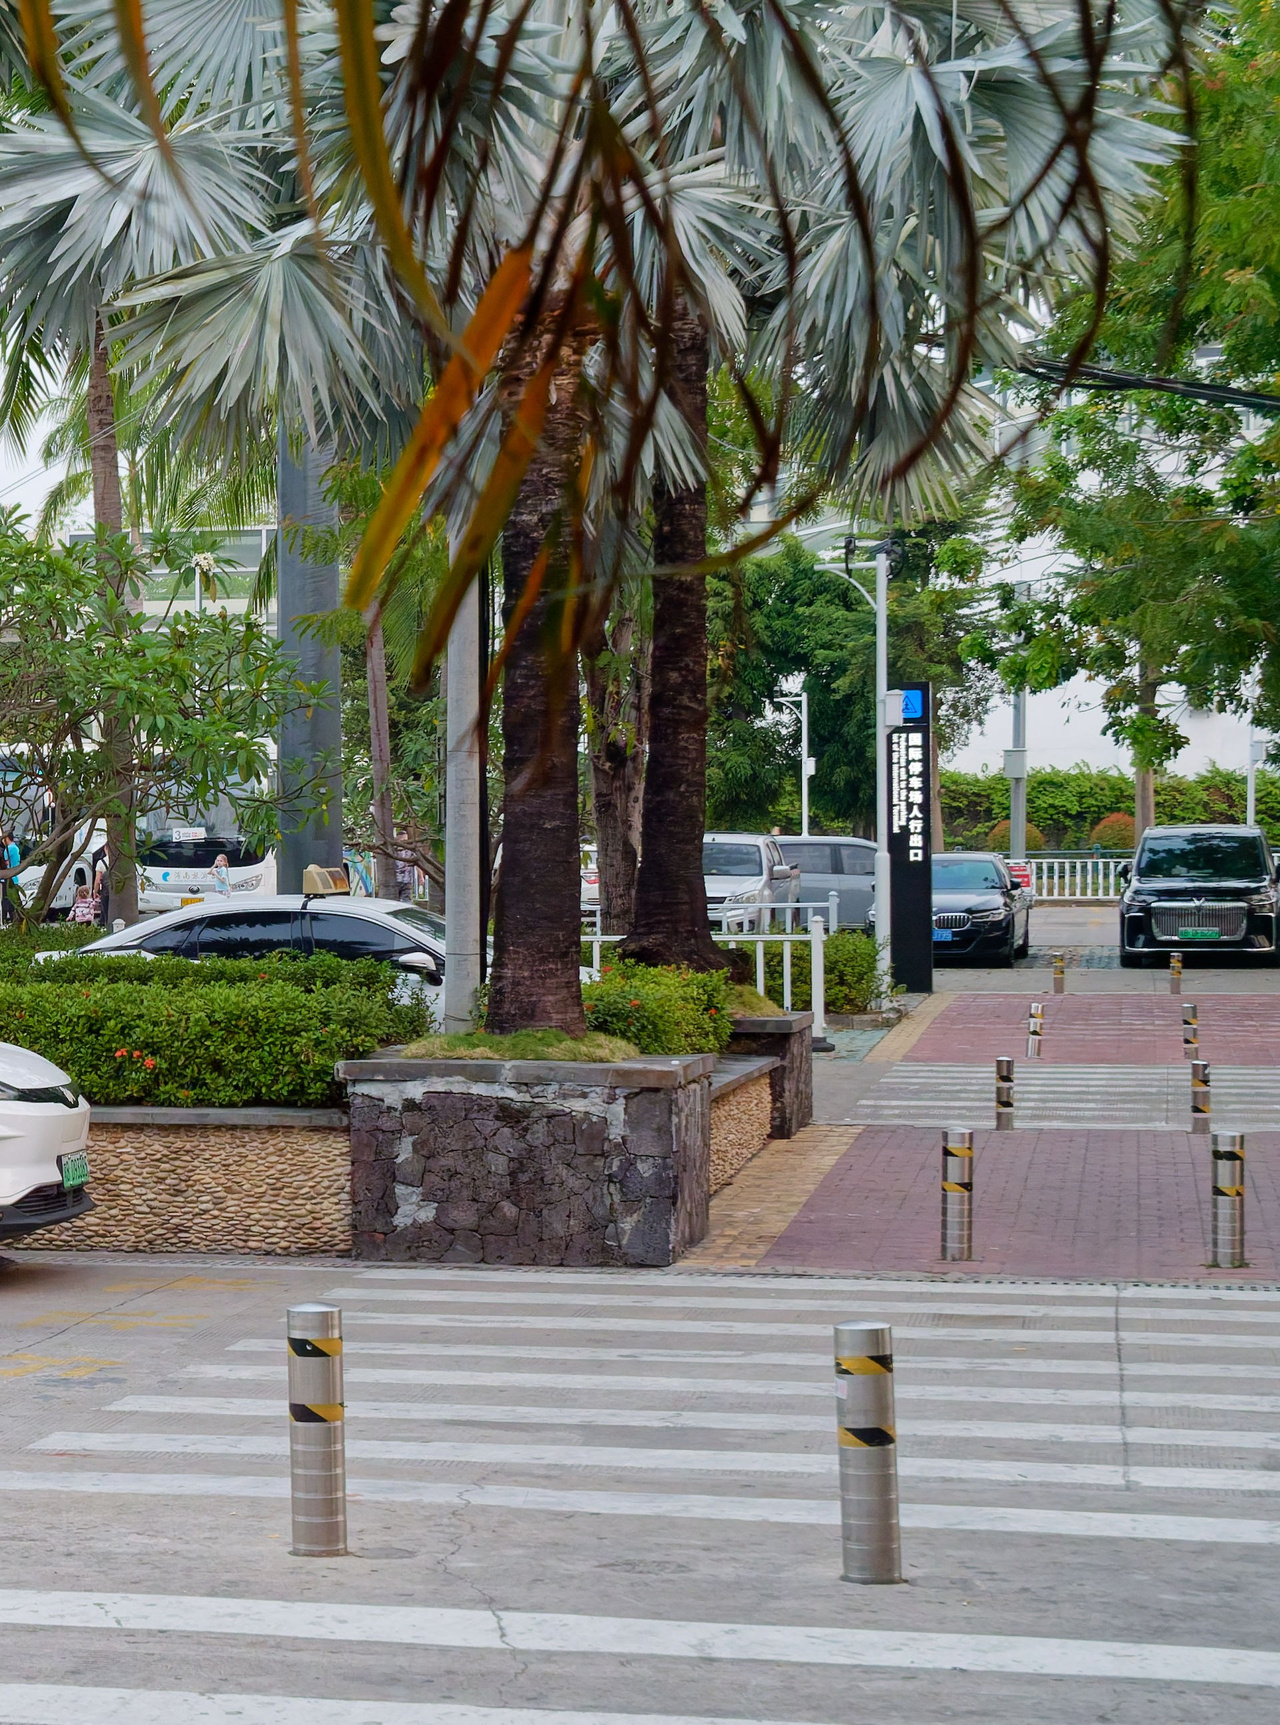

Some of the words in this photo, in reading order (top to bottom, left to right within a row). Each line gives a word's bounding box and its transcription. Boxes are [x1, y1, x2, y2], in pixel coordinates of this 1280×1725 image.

[892, 764, 900, 804] International
[908, 732, 923, 861] 国际停车场人行出口
[174, 830, 181, 840] 3
[892, 805, 900, 833] Terminal
